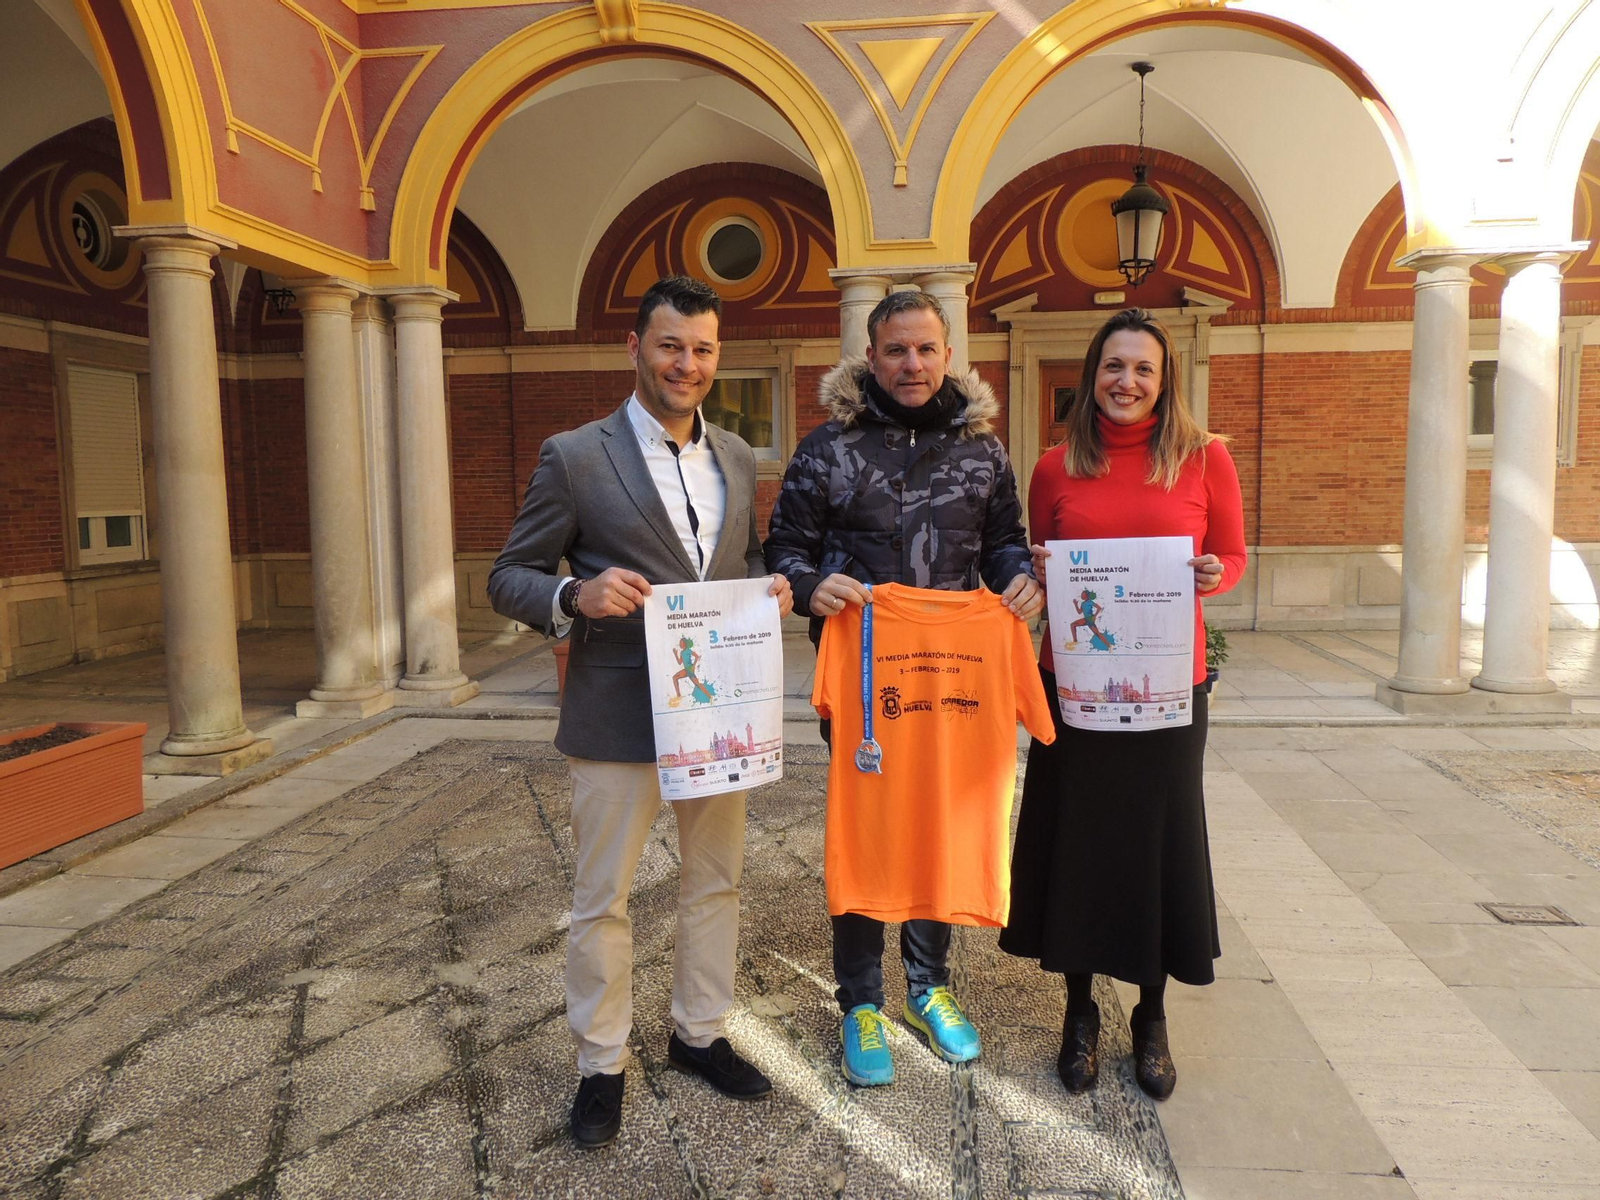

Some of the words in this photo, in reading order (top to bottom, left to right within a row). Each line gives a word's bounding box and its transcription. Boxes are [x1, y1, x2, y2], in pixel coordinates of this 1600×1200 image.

[1070, 551, 1088, 565] VI
[1114, 585, 1124, 598] 3
[666, 595, 684, 611] VI
[689, 610, 721, 619] MARATÓN
[708, 630, 718, 644] 3
[886, 654, 909, 662] MEDIA
[957, 654, 983, 663] HUELVA
[941, 698, 979, 707] CORREDOR
[904, 704, 932, 713] HUELVA
